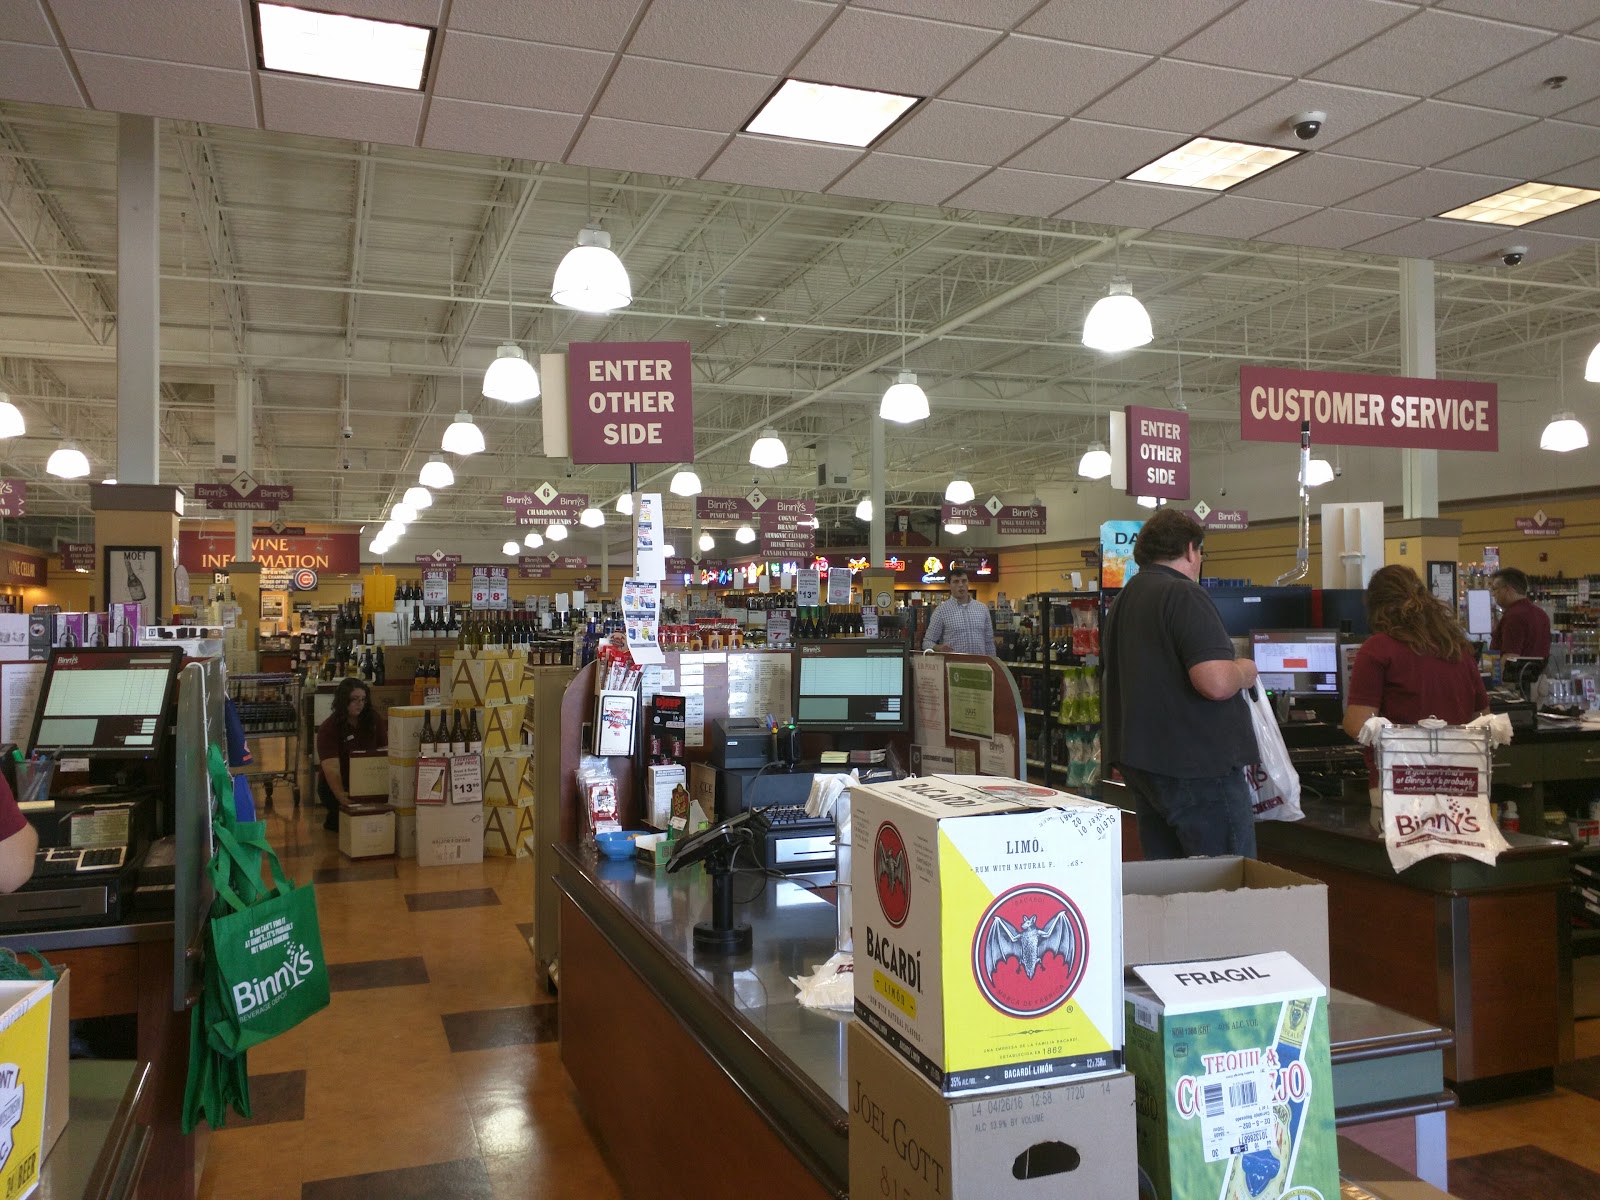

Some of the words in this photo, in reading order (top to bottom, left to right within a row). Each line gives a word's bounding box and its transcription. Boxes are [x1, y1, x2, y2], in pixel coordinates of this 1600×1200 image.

[589, 359, 672, 382] ENTER
[588, 391, 675, 414] OTHER
[1250, 386, 1385, 427] CUSTOMER
[1390, 395, 1490, 432] SERVICE
[603, 422, 663, 445] SIDE
[1140, 418, 1181, 441] ENTER
[1139, 442, 1182, 464] OTHER
[1147, 466, 1176, 486] SIDE
[240, 479, 248, 490] 7
[198, 486, 228, 498] Binny's
[260, 488, 290, 500] Binny's
[543, 488, 550, 498] 6
[753, 494, 760, 502] 5
[506, 494, 533, 505] Binny's
[560, 497, 586, 506] Binny's
[707, 500, 738, 511] Binny's
[990, 501, 997, 510] 4
[777, 501, 807, 513] Binny's
[951, 506, 978, 517] Binny's
[1012, 507, 1038, 518] Binny's
[1199, 505, 1205, 514] 3
[1218, 511, 1241, 522] Binny's
[1115, 532, 1138, 545] DA
[427, 571, 444, 579] SALE
[474, 567, 487, 576] SALE
[491, 568, 505, 576] SALE
[57, 655, 79, 665] Binny's
[427, 688, 440, 696] SAL
[964, 708, 977, 717] 1995
[1443, 778, 1475, 788] probably
[1395, 807, 1481, 836] Binny's
[1006, 837, 1044, 854] LIMÓ
[992, 863, 1011, 872] WITH
[1014, 862, 1046, 870] NATURAL
[866, 926, 921, 993] BACARDÍ
[233, 943, 314, 1015] Binny's
[1174, 965, 1271, 986] FRAGIL
[240, 1003, 271, 1023] BEVERAGE
[271, 990, 288, 1006] DEPOT
[1023, 999, 1032, 1007] DE
[1199, 1024, 1210, 1035] CRT
[1042, 1046, 1063, 1055] 1862
[1004, 1065, 1031, 1079] BACARDÍ
[1032, 1063, 1054, 1075] LIMÓN
[950, 1074, 962, 1087] 35%
[971, 1102, 982, 1117] L4
[987, 1096, 1023, 1114] 04/26/16
[1065, 1086, 1085, 1100] 7720
[1101, 1082, 1111, 1095] 14
[974, 1123, 987, 1133] ALC
[1010, 1118, 1018, 1127] BY
[1021, 1113, 1045, 1125] VOLUME
[853, 1079, 890, 1144] JOEL
[893, 1118, 944, 1195] GOTT
[18, 1152, 37, 1189] BEER
[880, 1165, 911, 1200] 81
